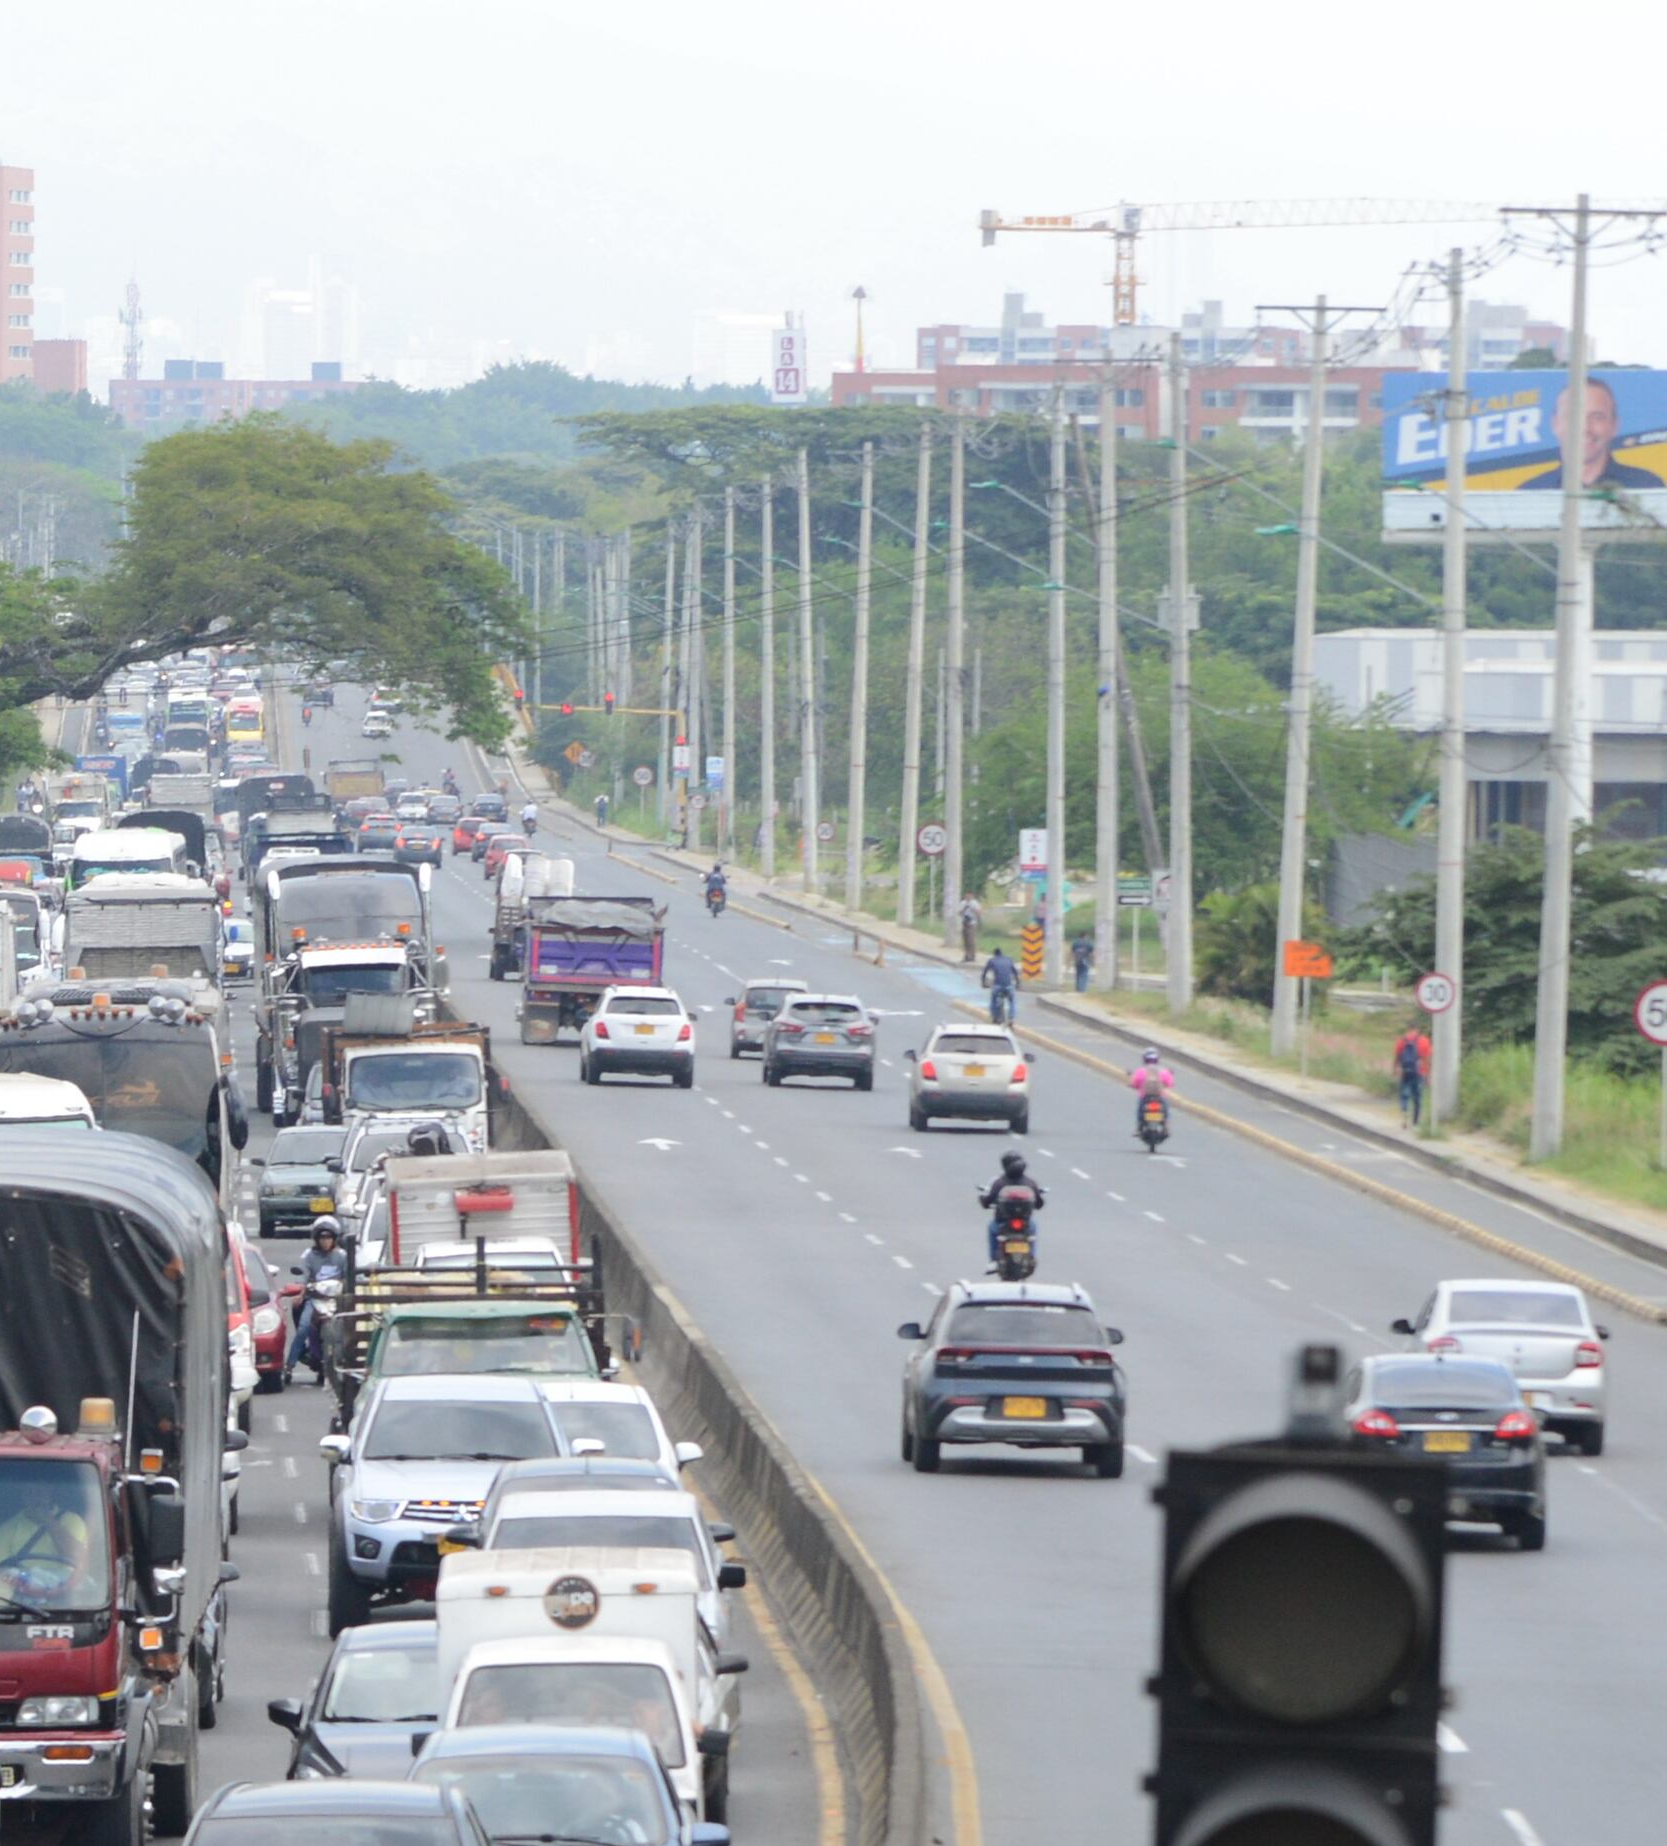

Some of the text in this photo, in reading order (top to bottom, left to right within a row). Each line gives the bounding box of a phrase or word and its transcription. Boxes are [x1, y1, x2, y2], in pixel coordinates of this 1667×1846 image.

[923, 831, 944, 847] 50
[1647, 999, 1667, 1028] 5
[27, 1625, 74, 1639] FTR
